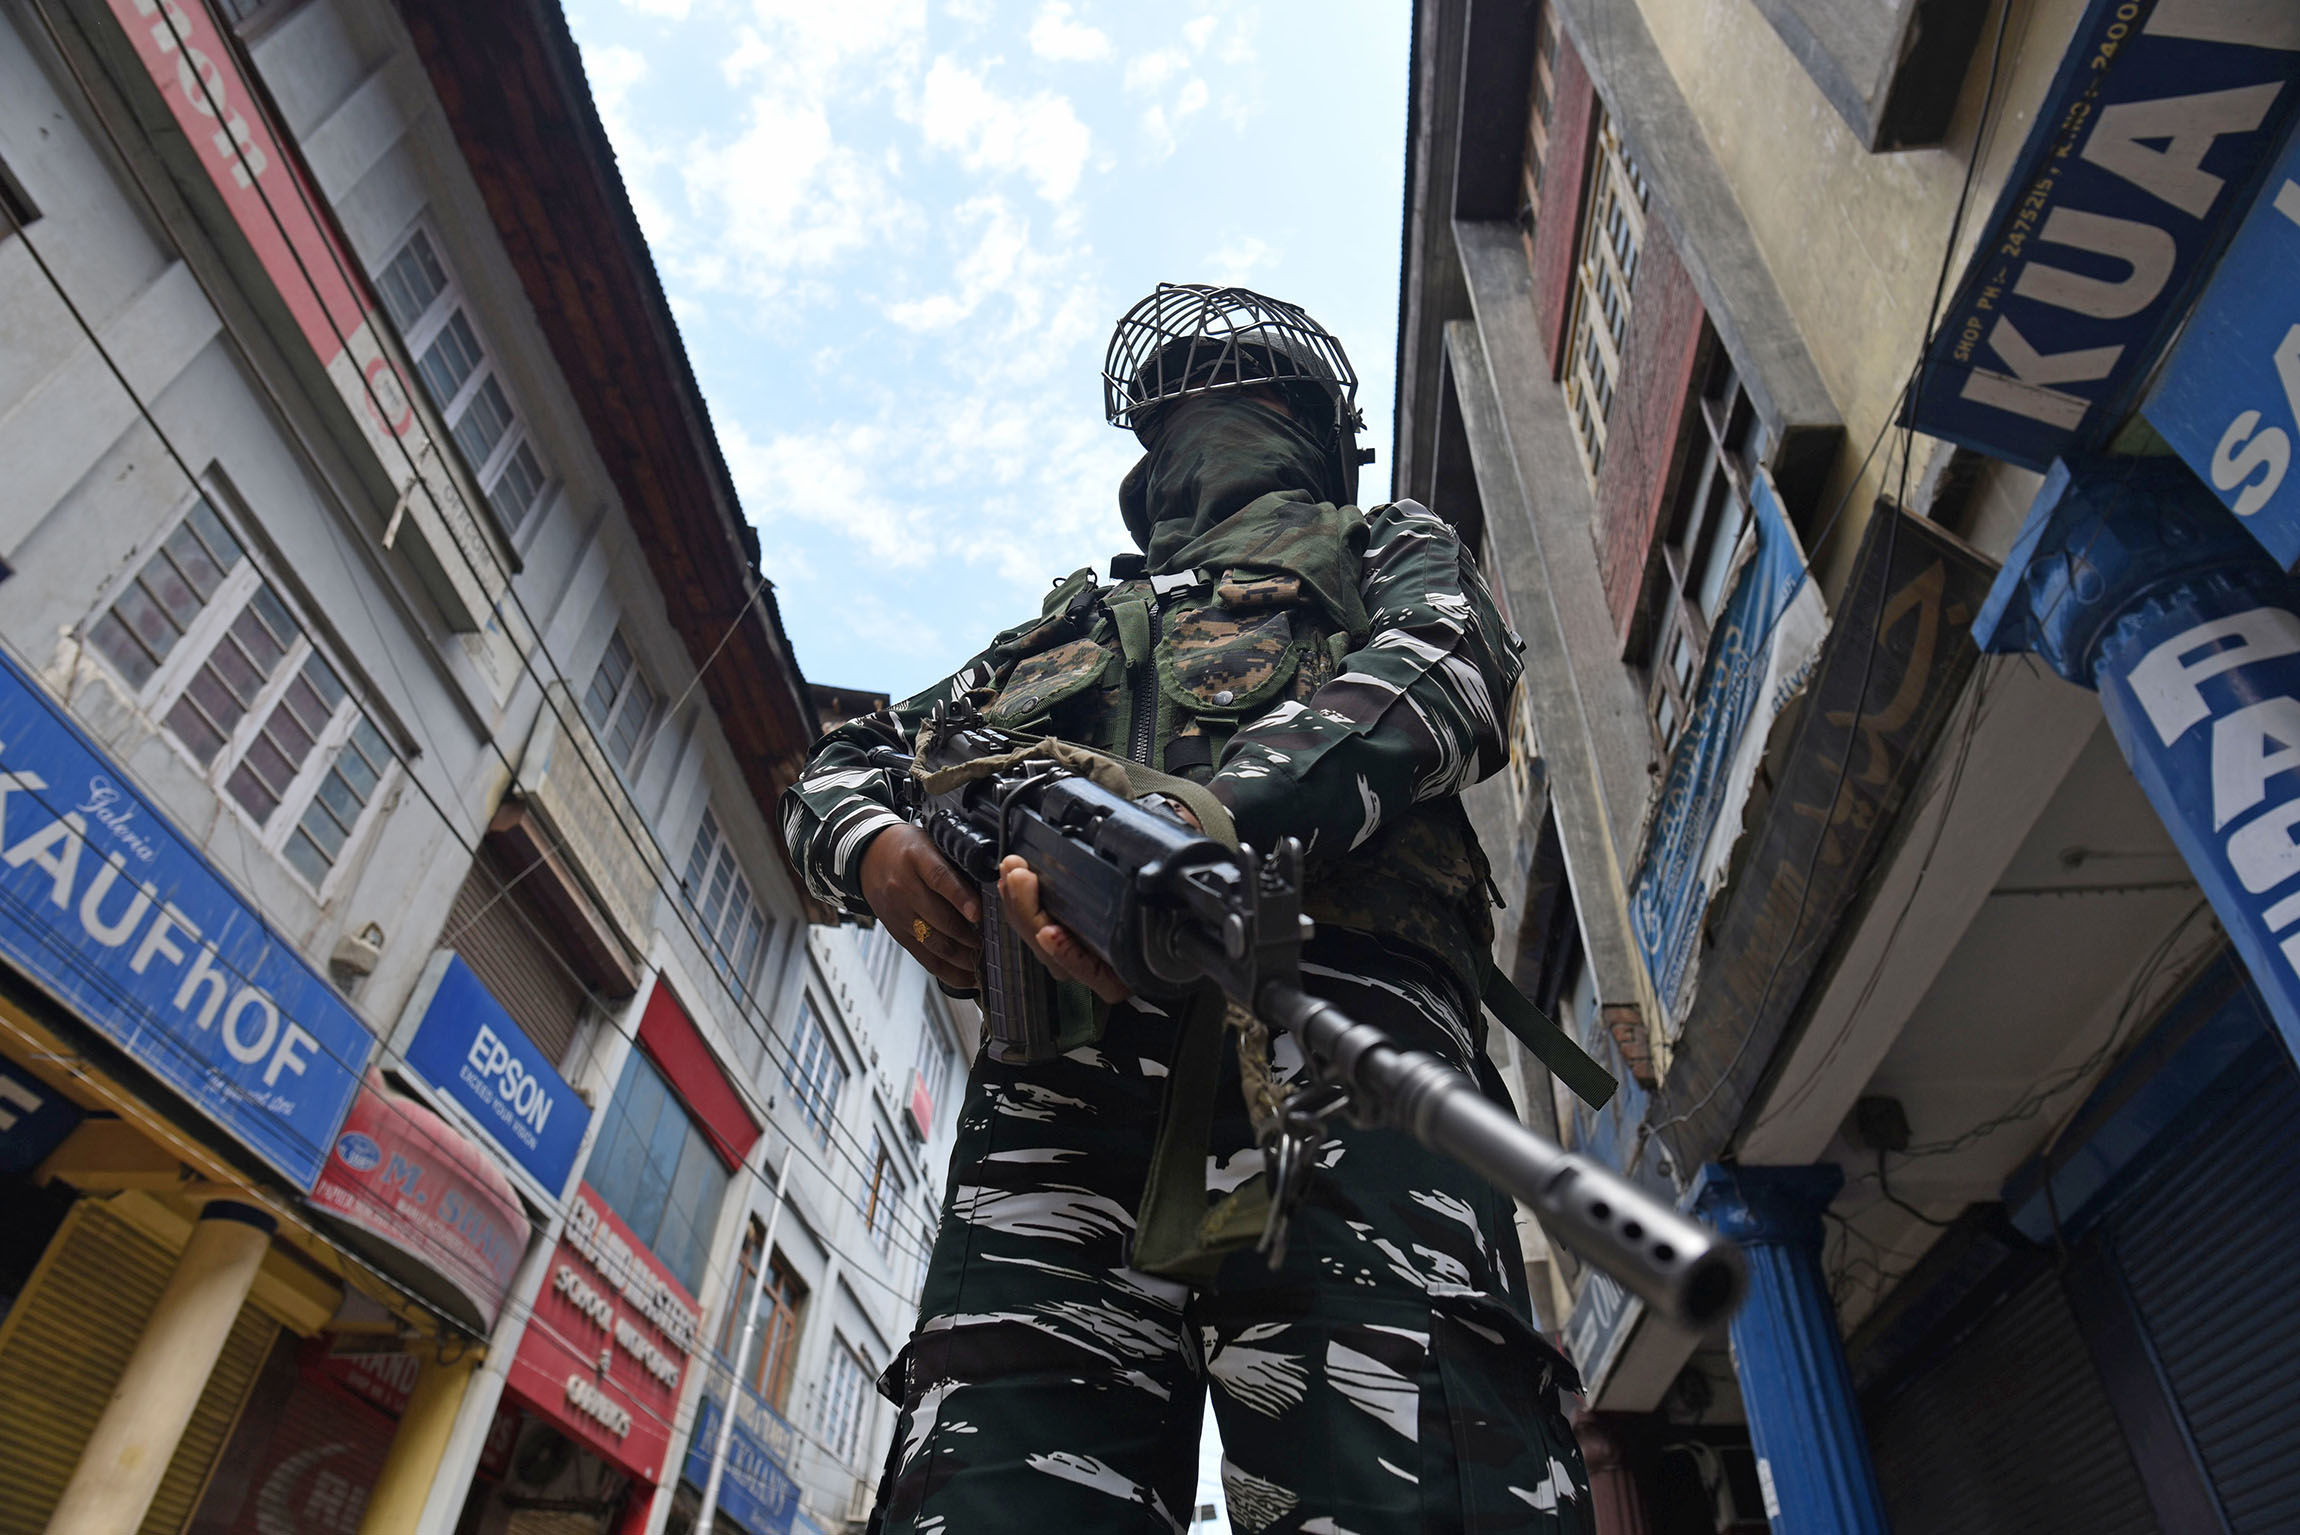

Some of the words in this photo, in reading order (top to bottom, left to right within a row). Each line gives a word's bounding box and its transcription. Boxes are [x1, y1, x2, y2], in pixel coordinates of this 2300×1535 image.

[1953, 317, 1983, 362] SHOP
[2091, 0, 2142, 71] 2400
[76, 774, 155, 864] Galeria
[467, 1022, 553, 1135] EPSON
[553, 1263, 615, 1334] SCHOOL
